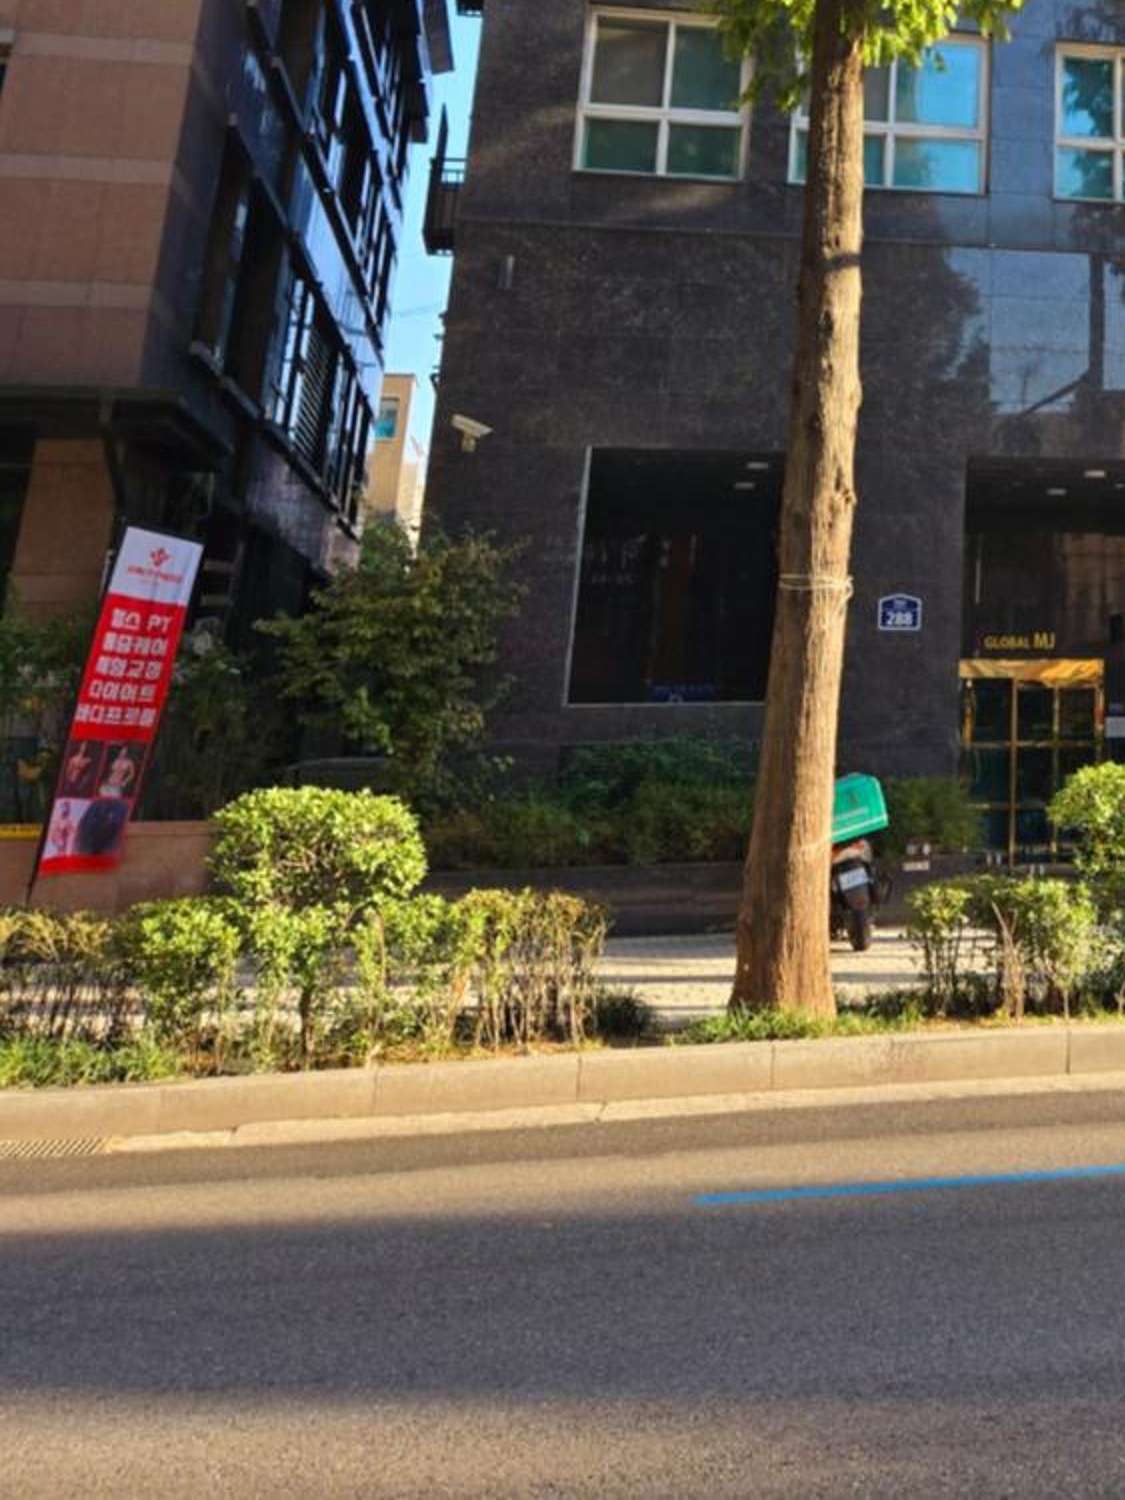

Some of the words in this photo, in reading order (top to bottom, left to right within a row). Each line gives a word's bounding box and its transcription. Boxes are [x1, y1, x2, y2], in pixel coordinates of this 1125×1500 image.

[148, 614, 172, 632] PT
[984, 635, 1030, 650] GLOBAL
[1033, 631, 1056, 650] MJ
[91, 680, 155, 702] 다이어트
